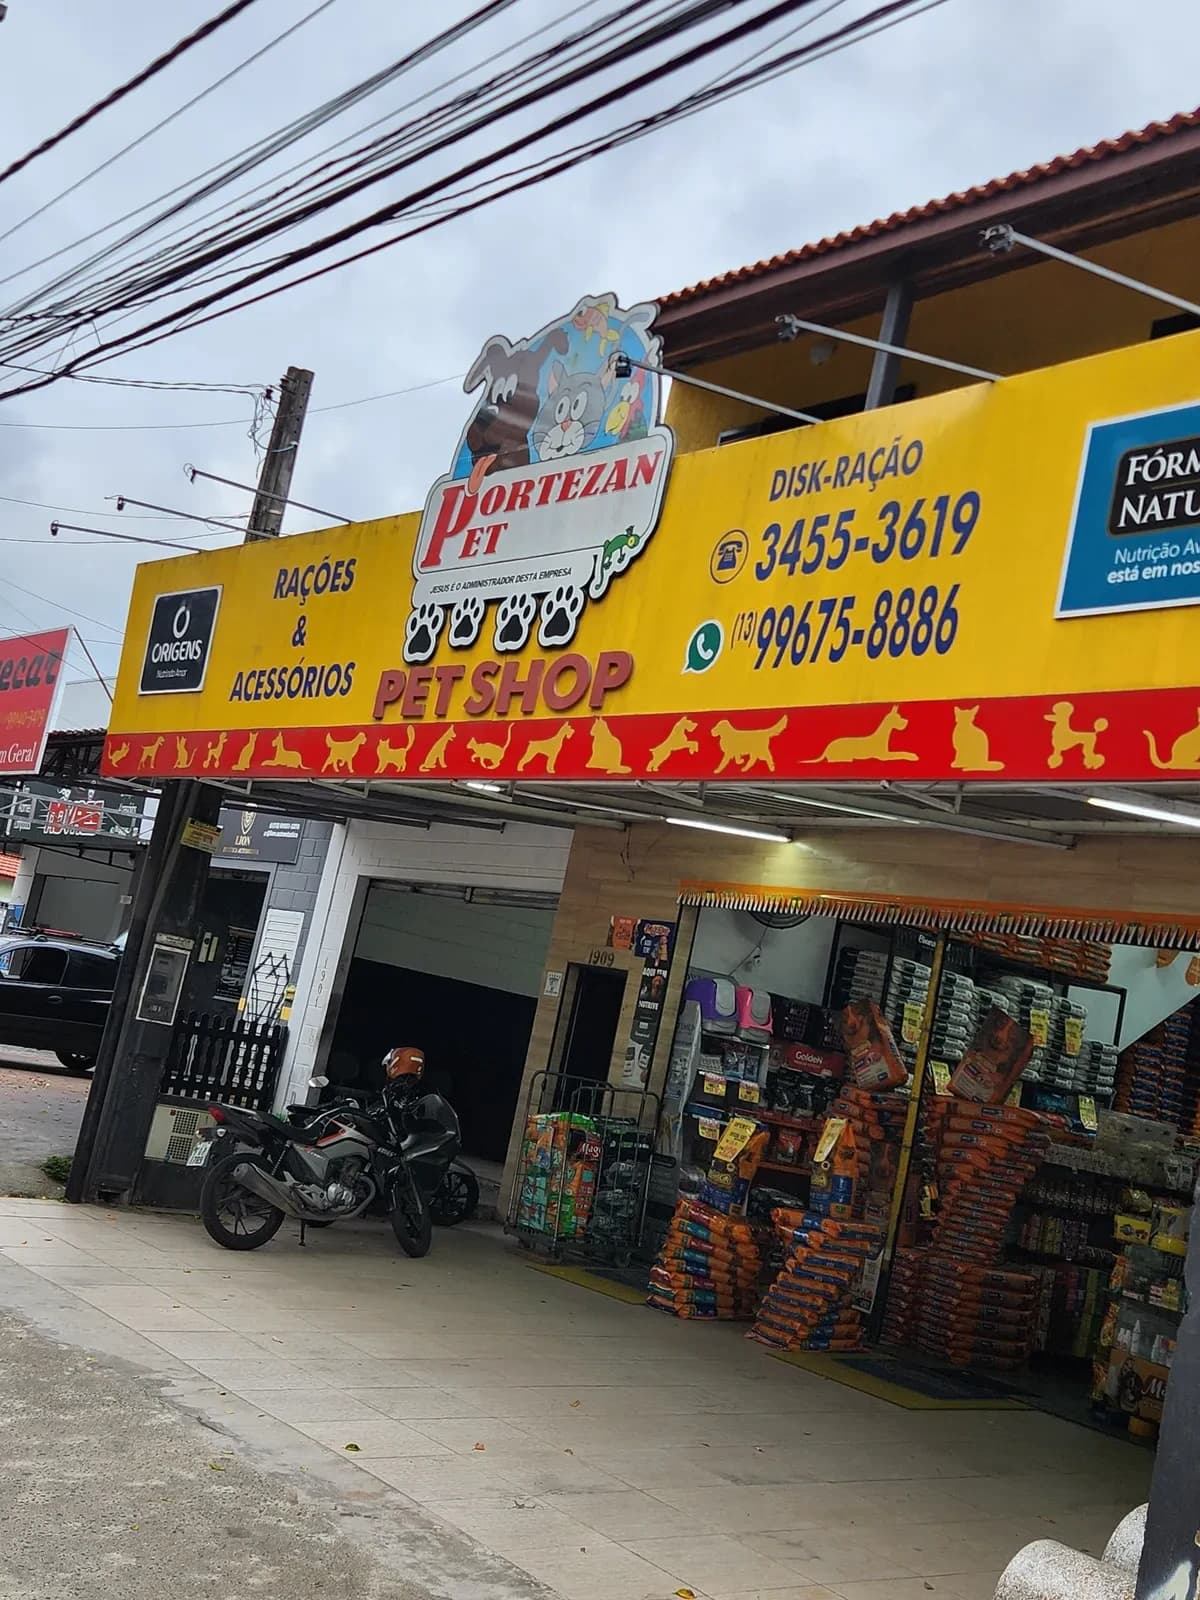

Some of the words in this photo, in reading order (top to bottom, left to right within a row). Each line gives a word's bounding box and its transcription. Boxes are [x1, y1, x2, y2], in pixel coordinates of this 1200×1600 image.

[769, 436, 923, 502] DISK-RAÇÃO
[420, 450, 664, 570] PORTEZAN
[755, 490, 981, 582] 3455-3619
[1114, 544, 1180, 565] Nutrição
[273, 554, 357, 606] RAÇÕES
[429, 583, 450, 594] JESUS
[455, 582, 461, 590] O
[461, 575, 514, 590] ADMINISTRADOR
[515, 572, 537, 583] DESTA
[538, 568, 572, 580] EMPRESA
[1107, 567, 1139, 584] está
[1142, 565, 1167, 579] em
[291, 615, 307, 647] &
[151, 639, 203, 663] ORIGENS
[229, 656, 356, 702] ACESSÓRIOS
[373, 665, 466, 720] PET
[463, 651, 634, 715] SHOP
[8, 741, 37, 764] Geral
[588, 950, 615, 967] 1909
